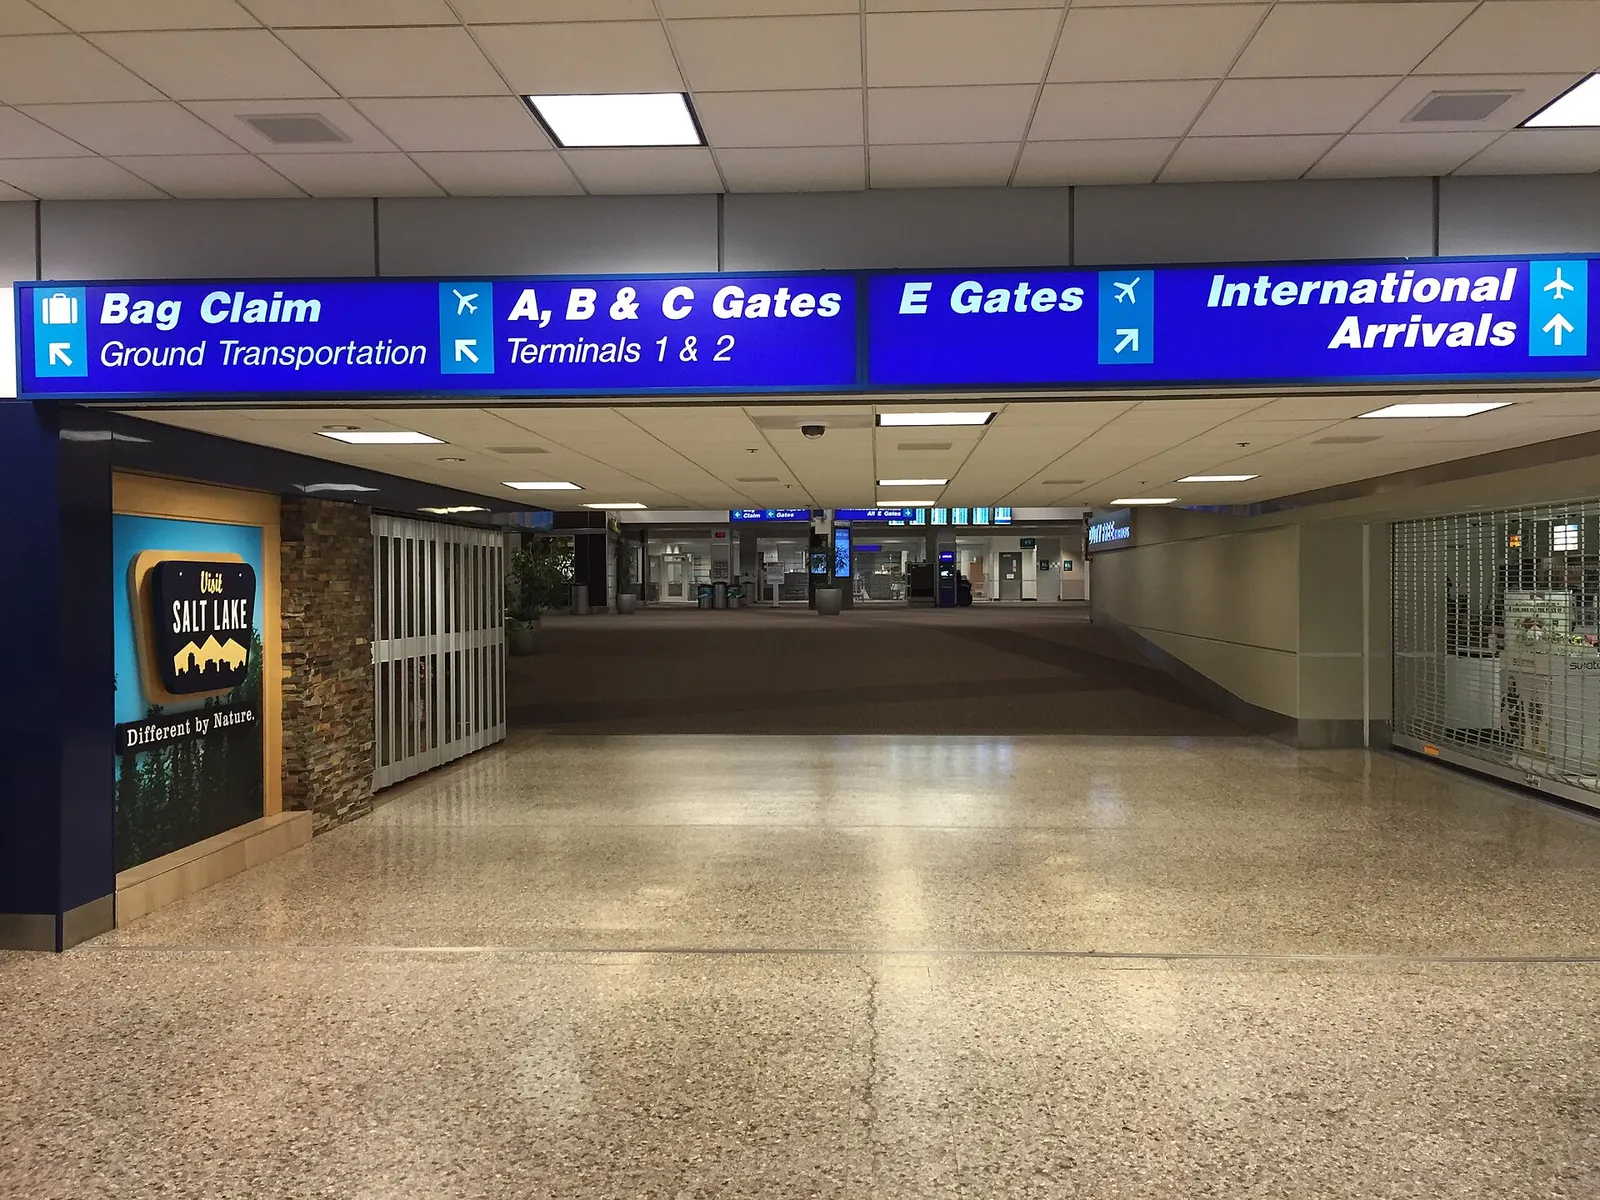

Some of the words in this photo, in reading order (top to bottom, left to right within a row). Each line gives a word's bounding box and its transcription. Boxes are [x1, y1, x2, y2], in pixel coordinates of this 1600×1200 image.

[898, 281, 933, 315] E
[950, 280, 1085, 314] Gates
[1207, 267, 1518, 308] International
[100, 292, 182, 331] Bag
[200, 290, 322, 324] Claim
[508, 288, 552, 329] A,
[565, 288, 597, 321] B
[609, 287, 640, 321] &
[661, 286, 695, 320] C
[712, 285, 842, 319] Gates
[1327, 312, 1517, 349] Arrivals
[100, 340, 207, 367] Ground
[219, 338, 427, 370] Transportation
[507, 336, 642, 364] Terminals
[655, 335, 668, 362] 1
[679, 335, 698, 362] &
[712, 334, 736, 362] 2
[200, 571, 223, 594] Visit
[172, 600, 207, 634] SALT
[213, 599, 248, 631] LAKE
[126, 718, 191, 747] Different
[195, 717, 210, 735] by
[213, 710, 255, 728] Nature.
